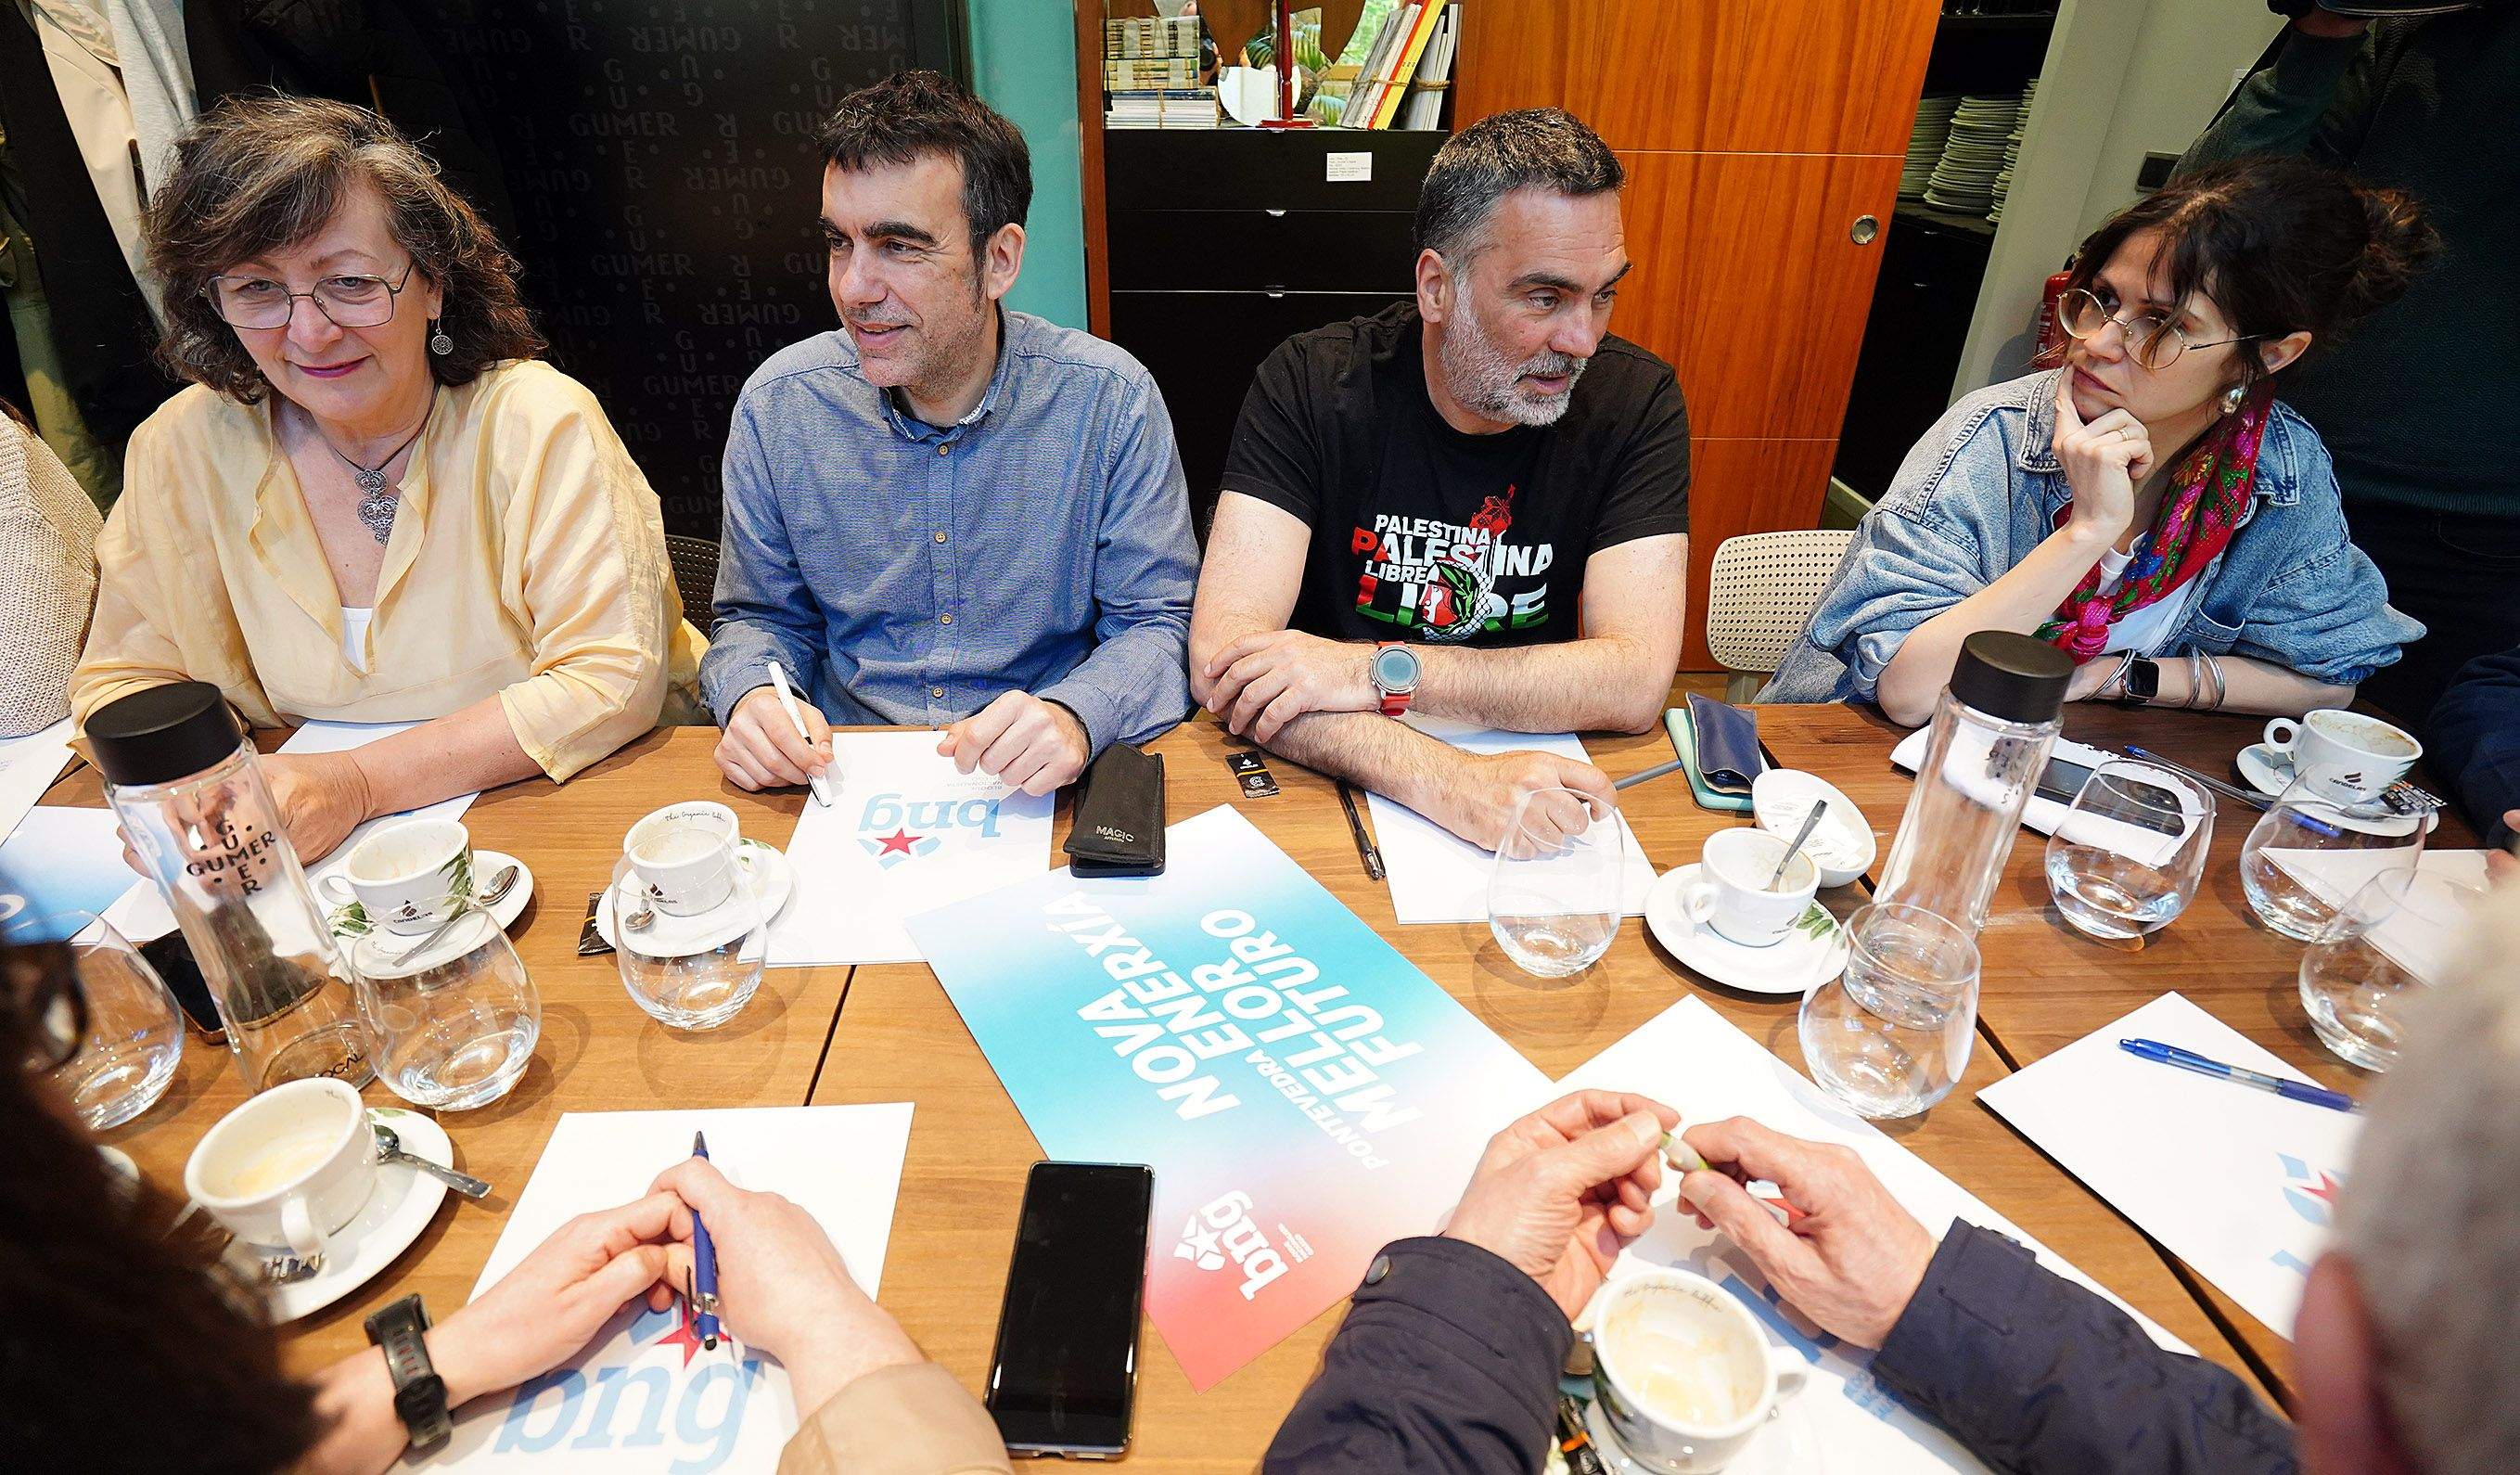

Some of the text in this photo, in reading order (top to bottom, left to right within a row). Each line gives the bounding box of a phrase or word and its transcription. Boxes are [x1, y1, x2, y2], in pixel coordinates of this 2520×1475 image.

[568, 111, 680, 137] GUMER
[1374, 514, 1491, 546] PALESTINA
[1364, 559, 1429, 584] LIBRE
[186, 831, 276, 877] GUMER
[859, 793, 1002, 839] bng
[1095, 825, 1134, 842] MAGIC
[1042, 890, 1257, 1060] ENERXÍA
[1200, 908, 1426, 1067] FUTURO
[1076, 988, 1242, 1122] NOVA
[1191, 956, 1426, 1134] MELLOR
[1244, 1048, 1390, 1170] PONTEVEDRA
[1198, 1189, 1290, 1302] bng
